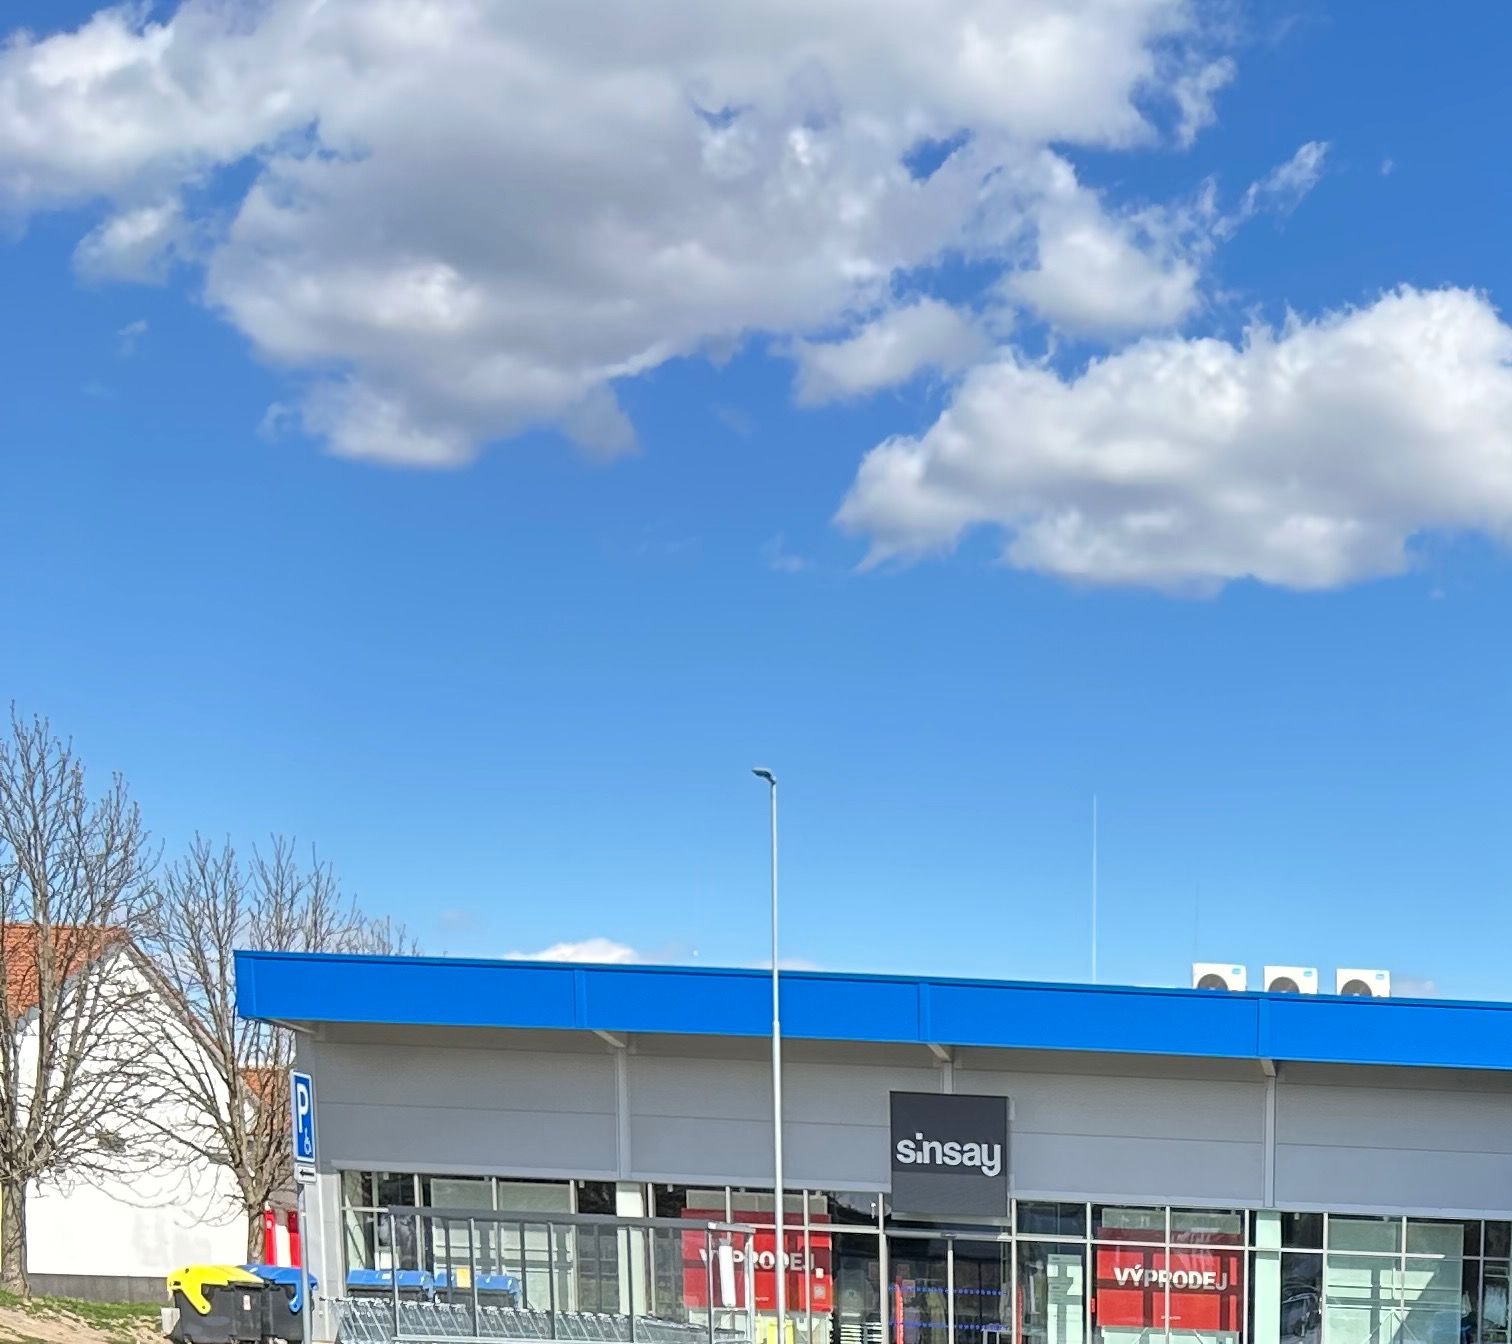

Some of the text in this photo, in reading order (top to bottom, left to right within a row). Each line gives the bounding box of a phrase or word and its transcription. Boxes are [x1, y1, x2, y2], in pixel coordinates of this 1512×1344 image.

[297, 1083, 309, 1133] P
[896, 1133, 1001, 1177] sinsay
[1113, 1264, 1228, 1290] VÝPRODEJ
